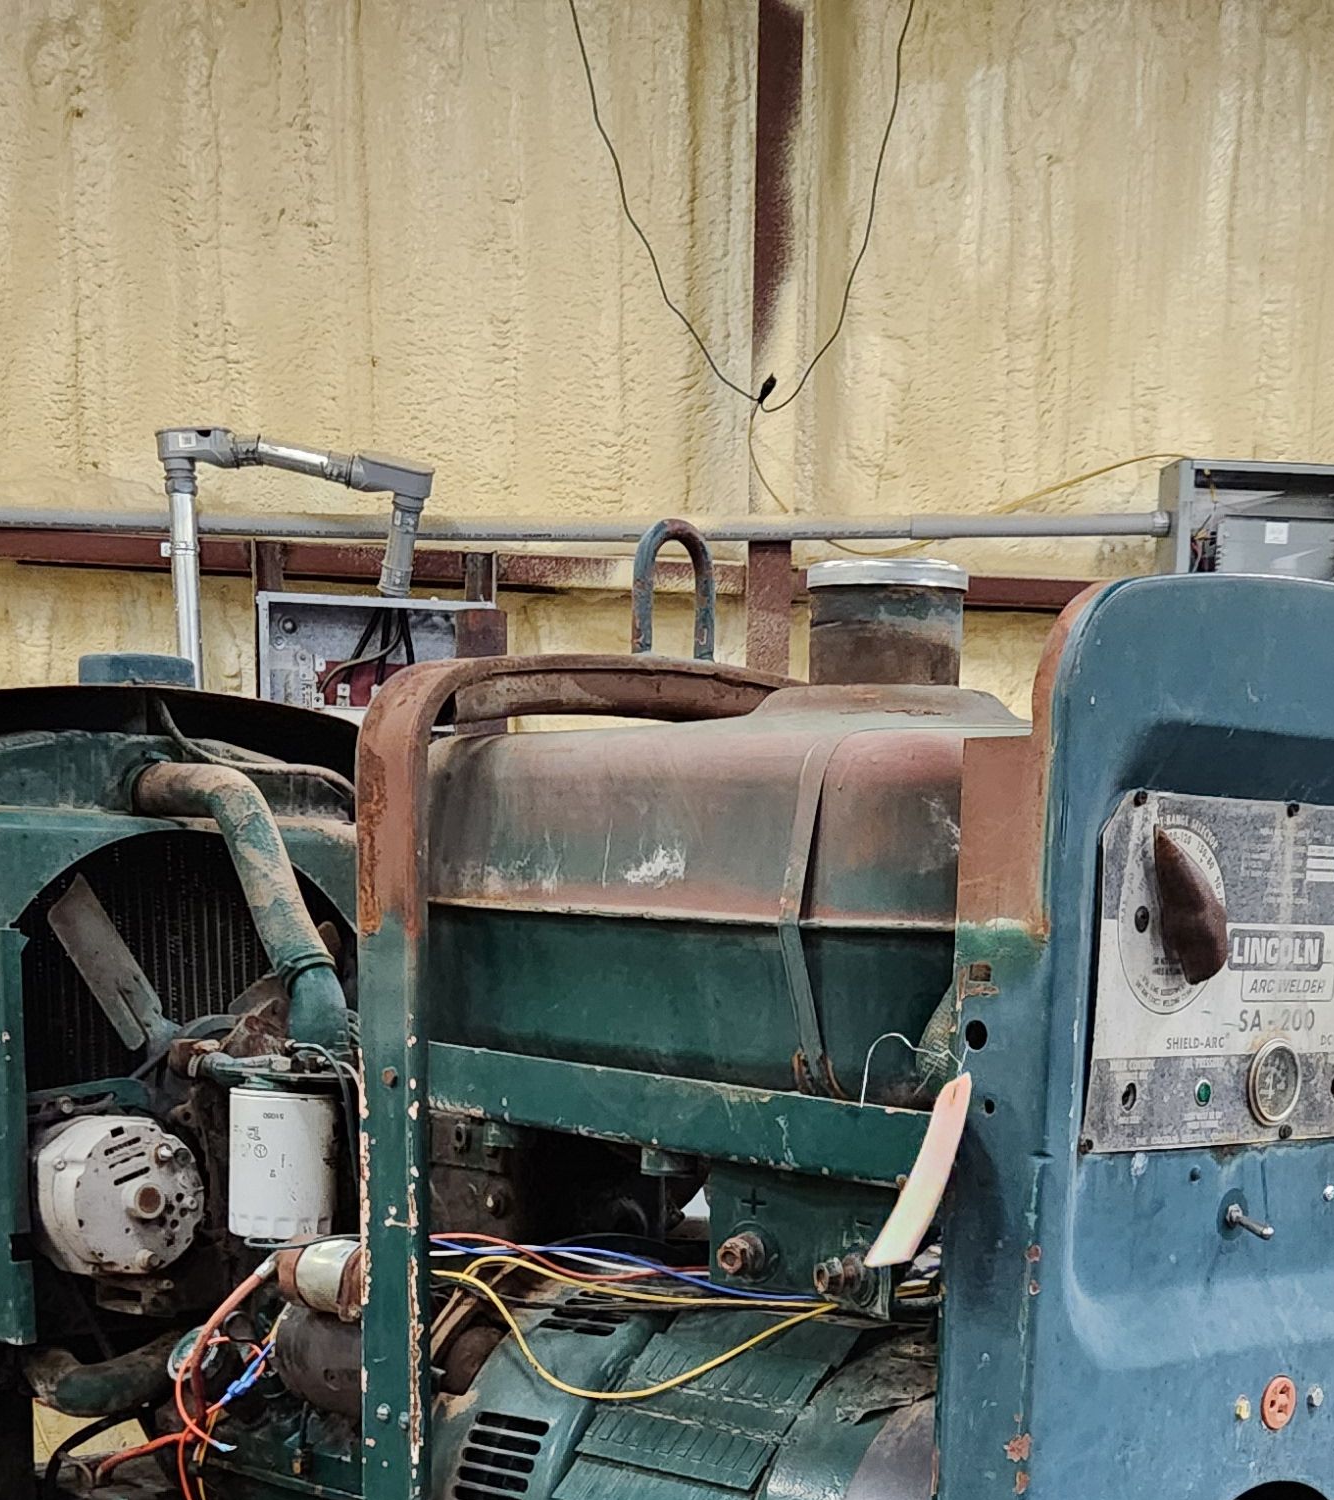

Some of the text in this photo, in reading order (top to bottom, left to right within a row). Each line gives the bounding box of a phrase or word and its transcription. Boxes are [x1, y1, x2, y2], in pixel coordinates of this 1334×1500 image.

[1232, 937, 1321, 965] LINCOLN
[1250, 979, 1326, 994] ARC WELDER
